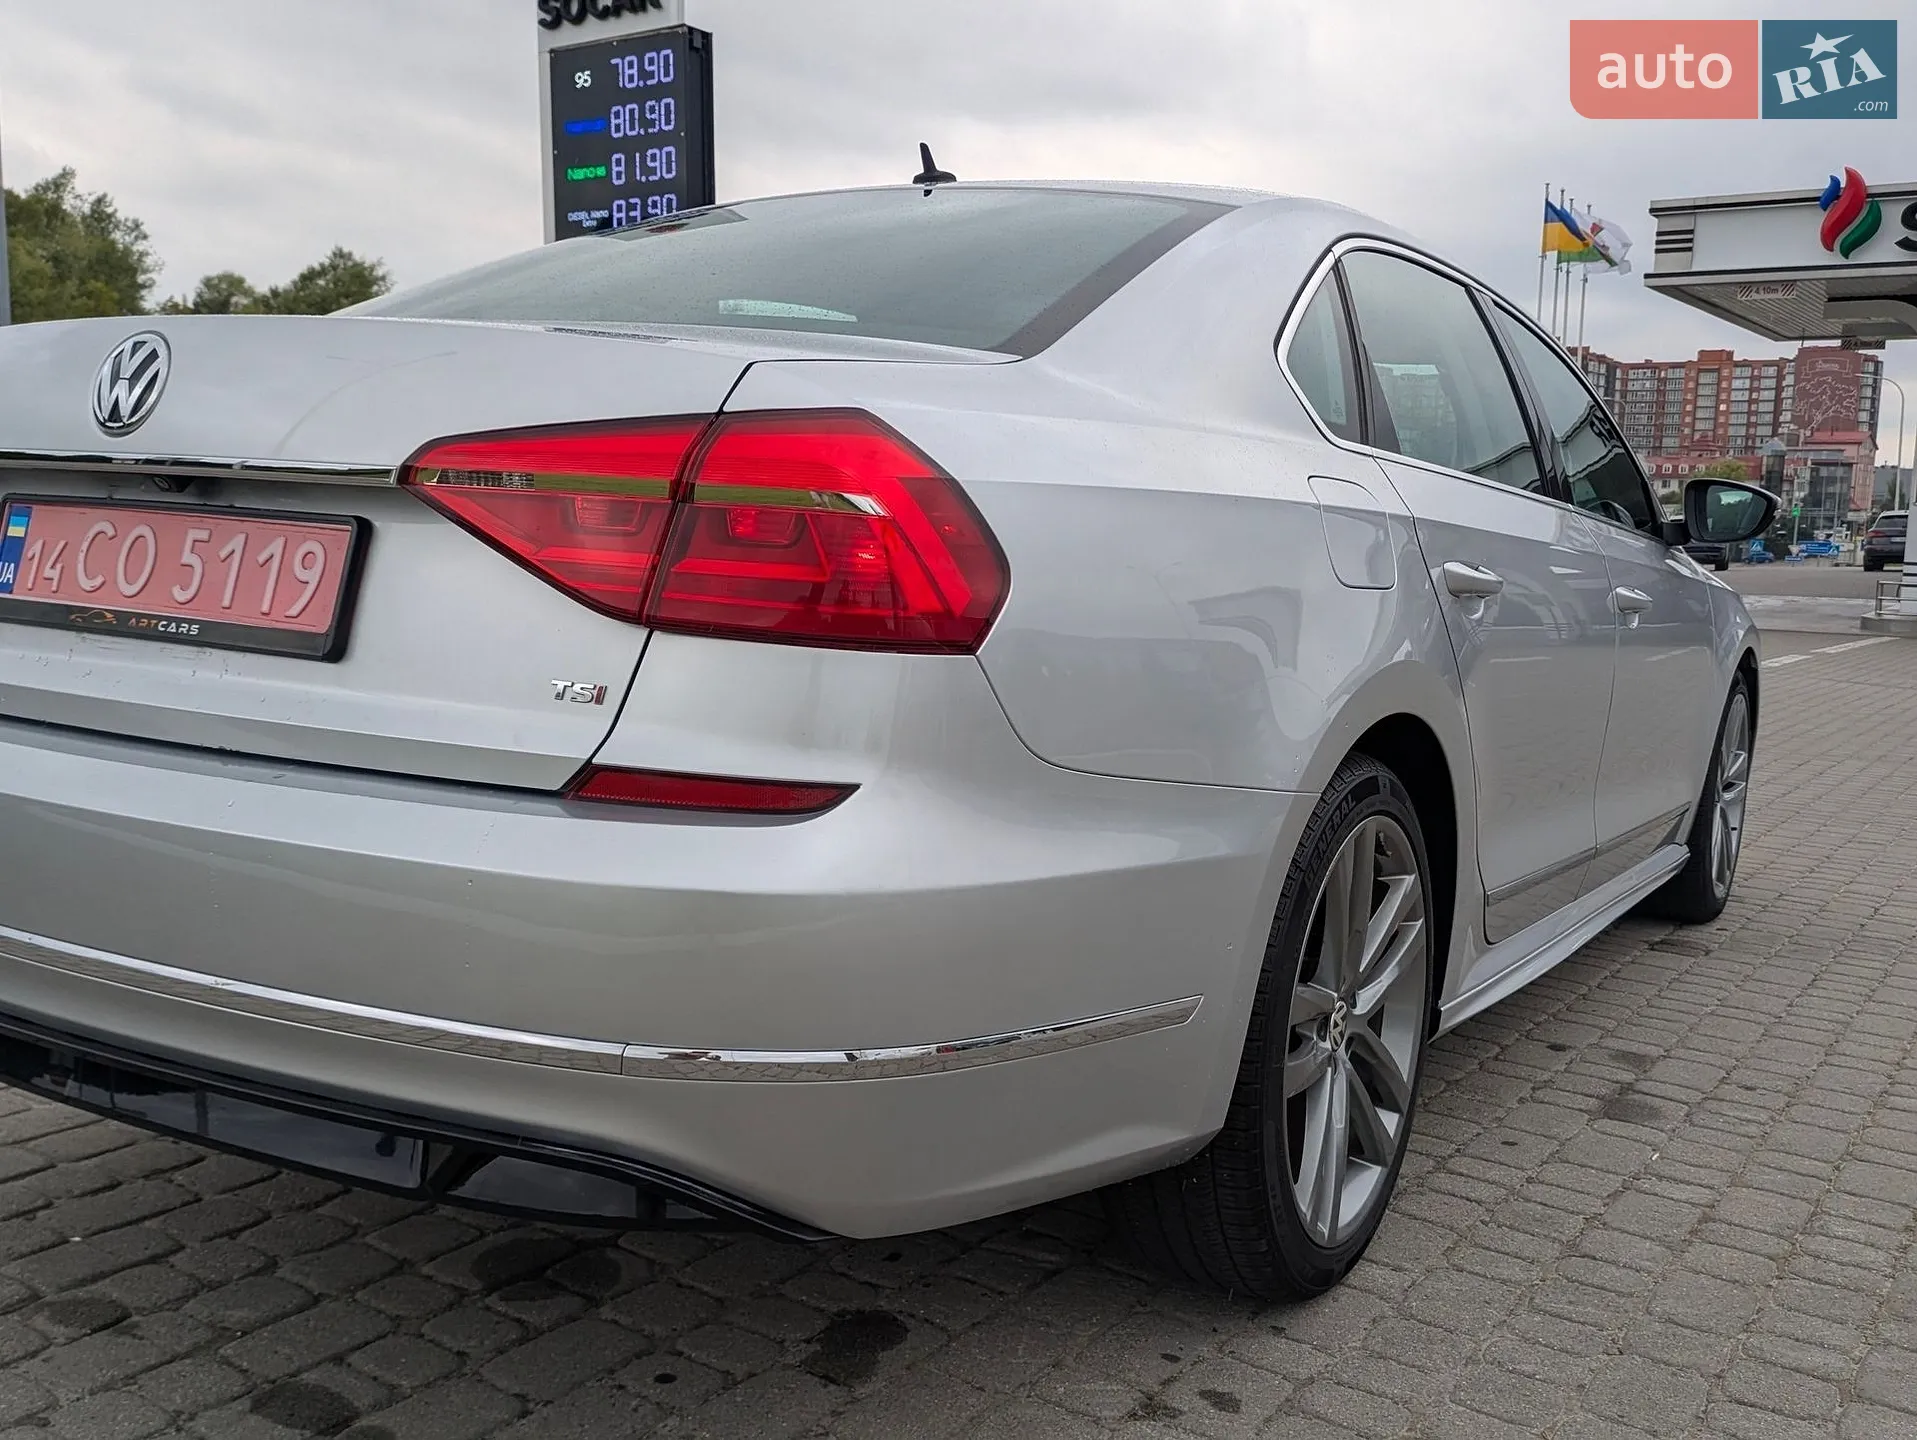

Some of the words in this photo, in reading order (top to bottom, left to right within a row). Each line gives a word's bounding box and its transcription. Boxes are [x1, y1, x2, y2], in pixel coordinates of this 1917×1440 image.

[574, 70, 592, 88] 95
[610, 49, 674, 89] 78.90
[610, 97, 675, 138] 80.90
[611, 146, 676, 185] 81.90
[612, 193, 677, 229] 8390
[27, 537, 68, 593] 14
[76, 520, 157, 598] CO
[171, 528, 327, 618] 5119
[128, 615, 201, 635] ARTCARS
[550, 679, 608, 706] TSI
